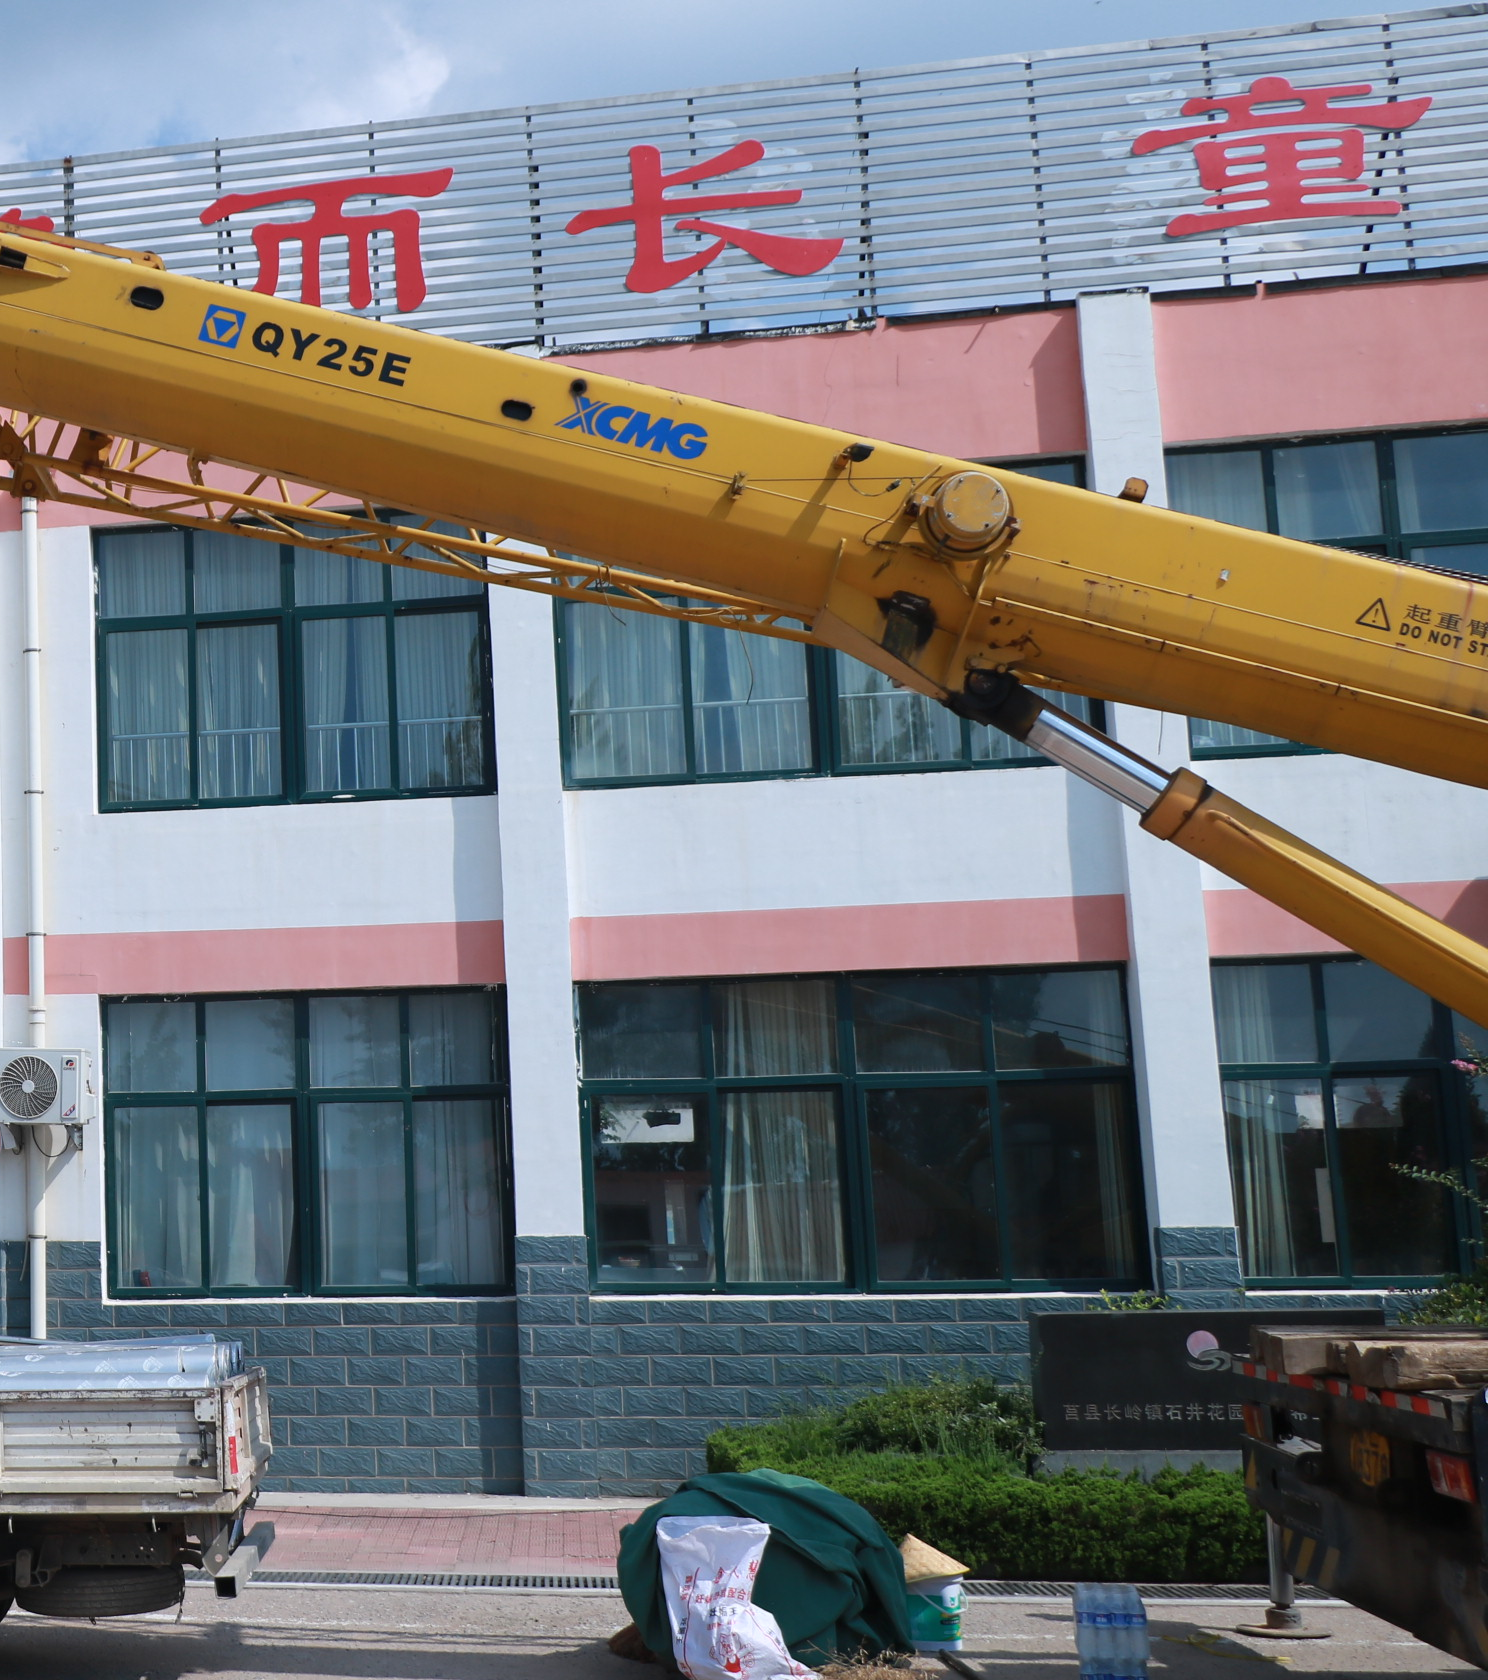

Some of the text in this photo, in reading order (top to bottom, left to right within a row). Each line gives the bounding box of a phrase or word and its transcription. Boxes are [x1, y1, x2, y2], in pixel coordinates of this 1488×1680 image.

[252, 320, 412, 387] QY25E
[554, 396, 708, 460] XCMG
[1399, 623, 1488, 657] DO NOT ST
